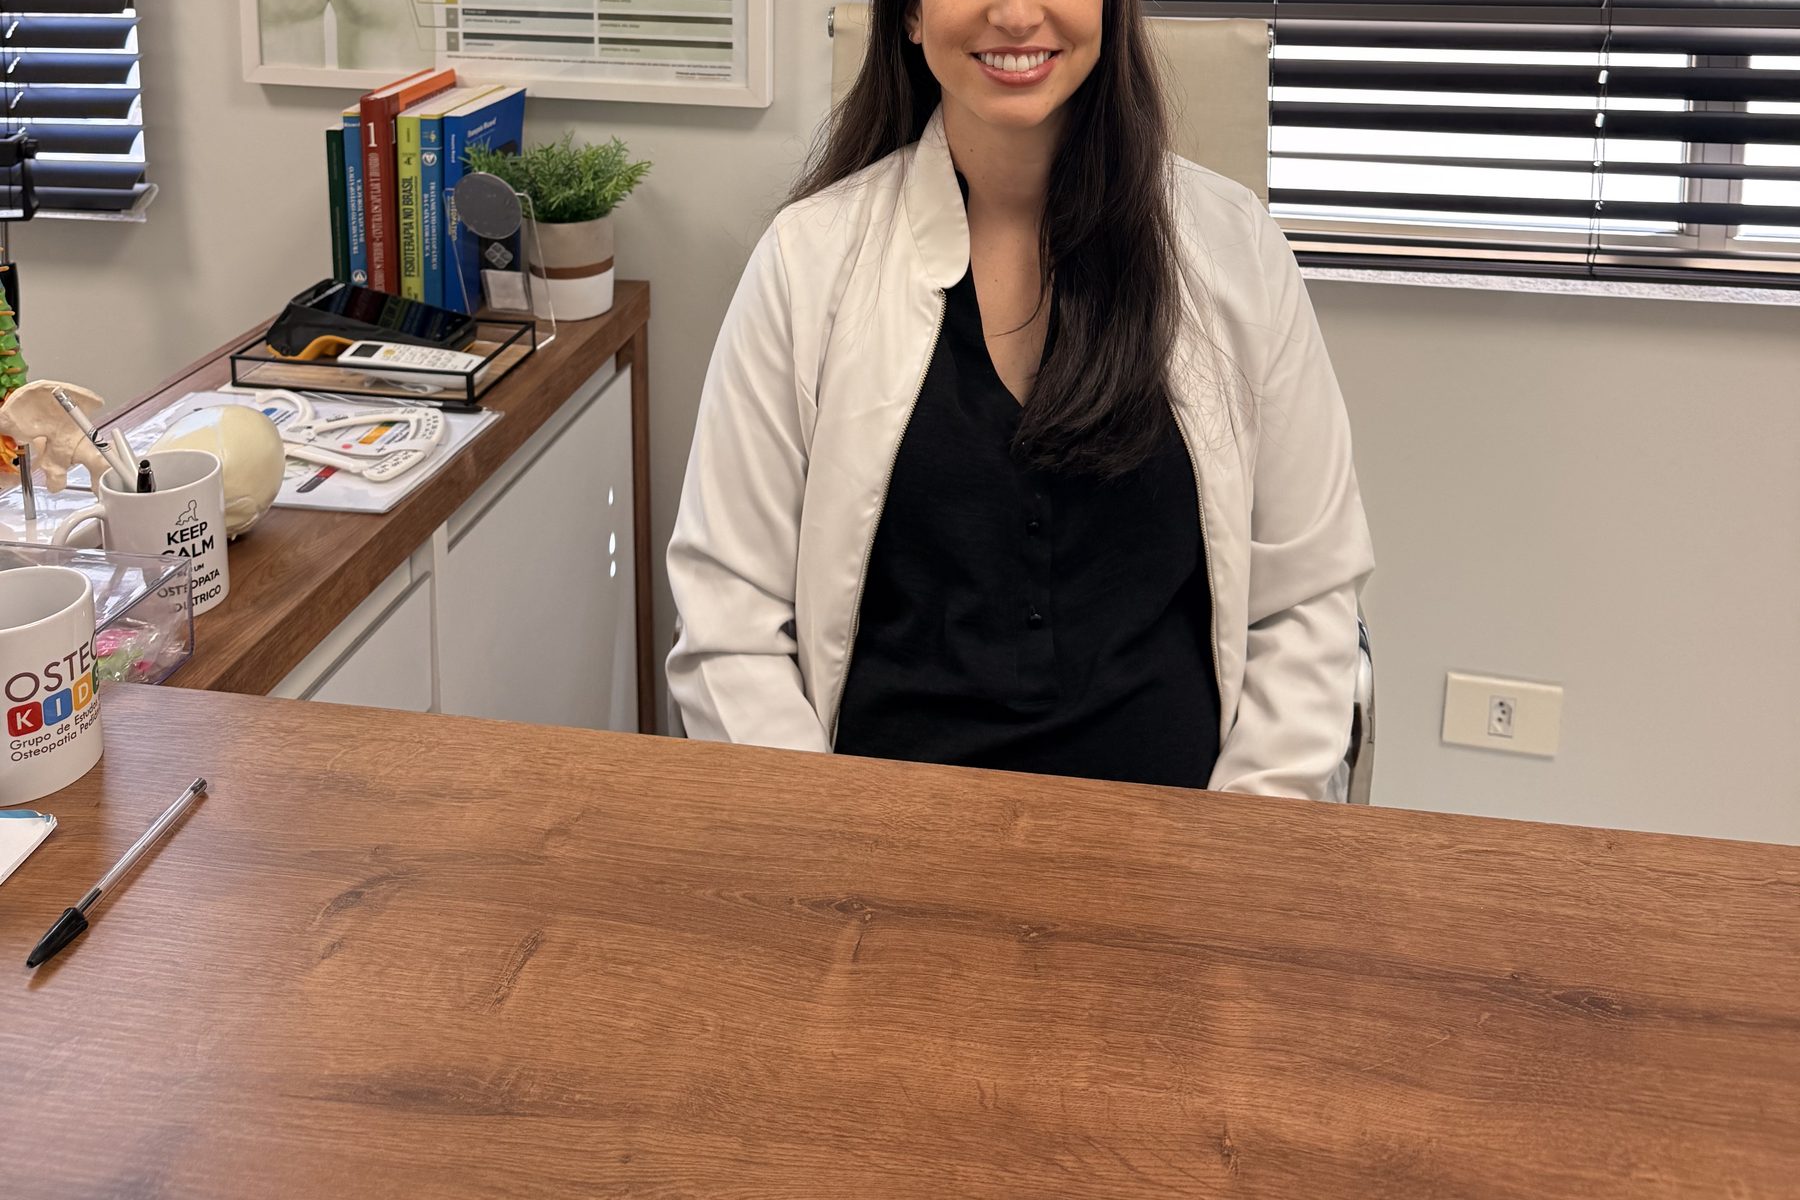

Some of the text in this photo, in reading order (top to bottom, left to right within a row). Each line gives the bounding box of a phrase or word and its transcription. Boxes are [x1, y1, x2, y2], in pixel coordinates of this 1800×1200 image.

[367, 122, 378, 147] 1
[401, 176, 413, 206] BRASIL
[403, 208, 414, 220] NO
[403, 222, 415, 278] FISIOTERAPIA
[167, 521, 208, 546] KEEP
[194, 563, 205, 572] UM
[9, 732, 52, 751] Grupo
[56, 722, 71, 735] de
[10, 730, 77, 762] Osteopatia
